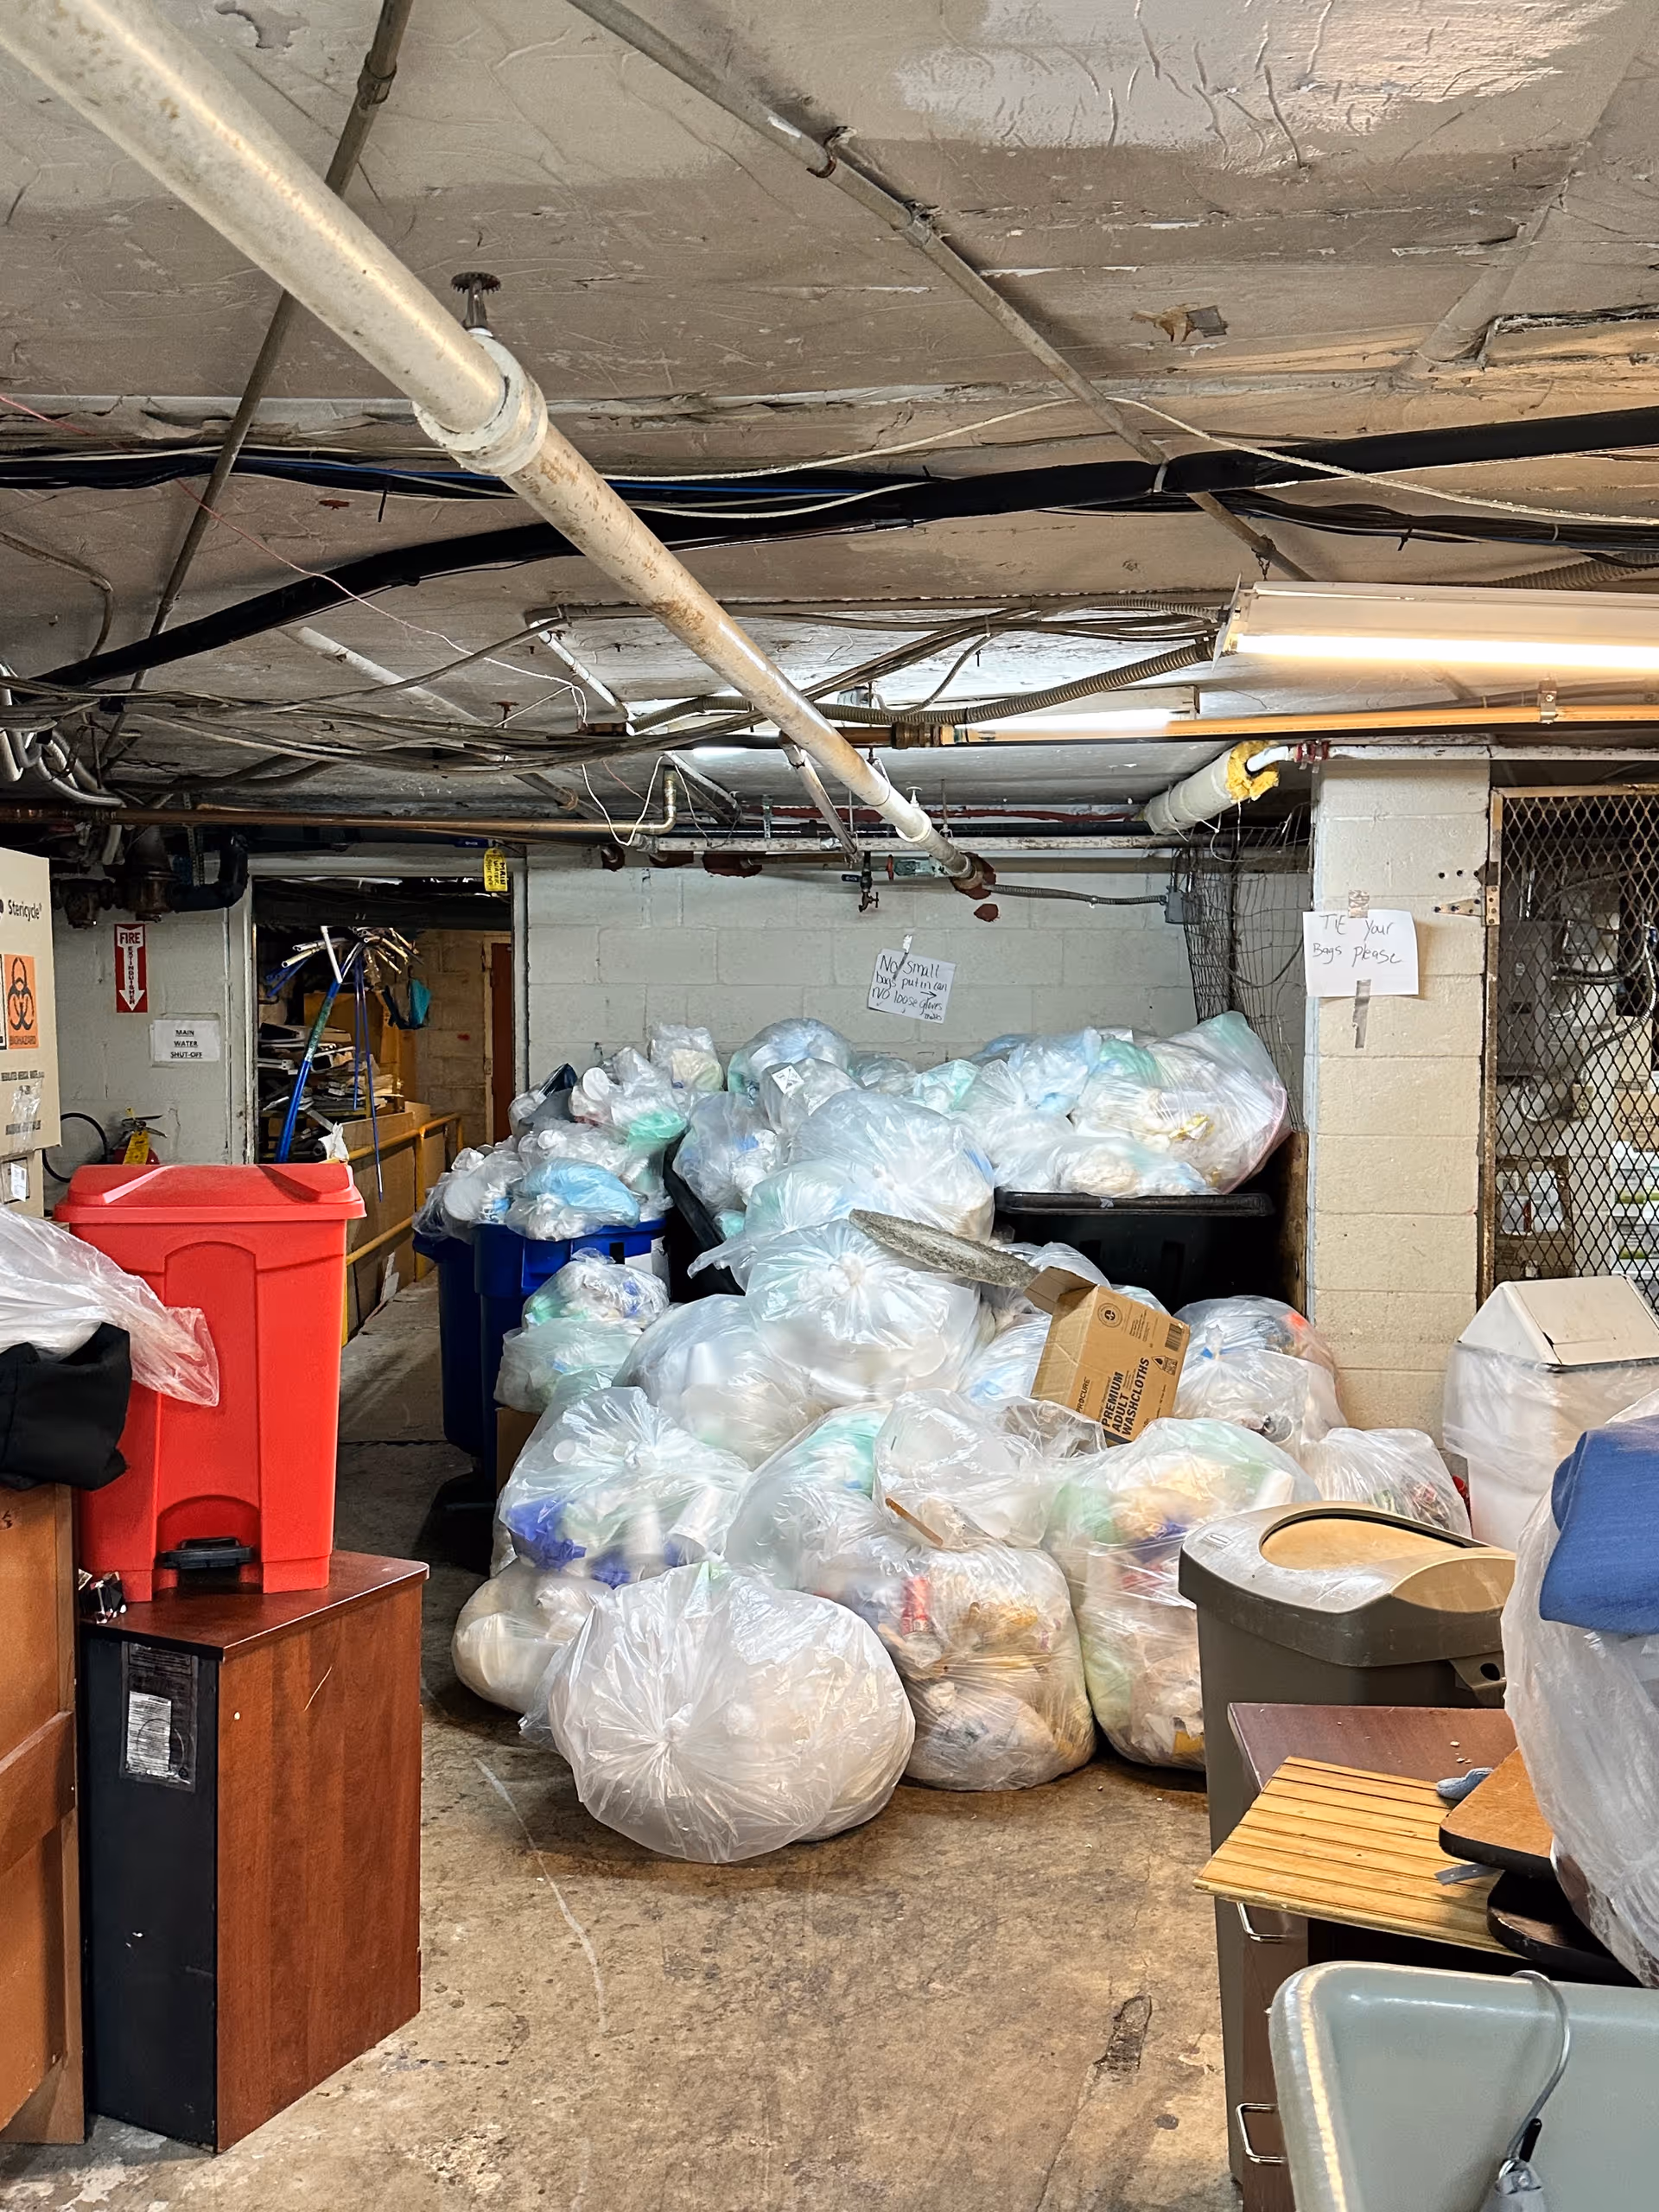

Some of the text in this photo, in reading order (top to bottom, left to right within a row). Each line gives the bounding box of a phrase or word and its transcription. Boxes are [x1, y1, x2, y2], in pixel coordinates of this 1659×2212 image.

[1319, 913, 1347, 935] TIE
[119, 932, 141, 944] FIRE
[1313, 943, 1342, 964] Bags
[876, 971, 897, 989] bags
[901, 977, 918, 989] put
[920, 981, 931, 989] in
[893, 990, 918, 1007] loose
[1101, 1371, 1124, 1427] PREMIUM
[1122, 1357, 1150, 1436] WASHCLOTHS
[1112, 1395, 1129, 1433] ADULT
